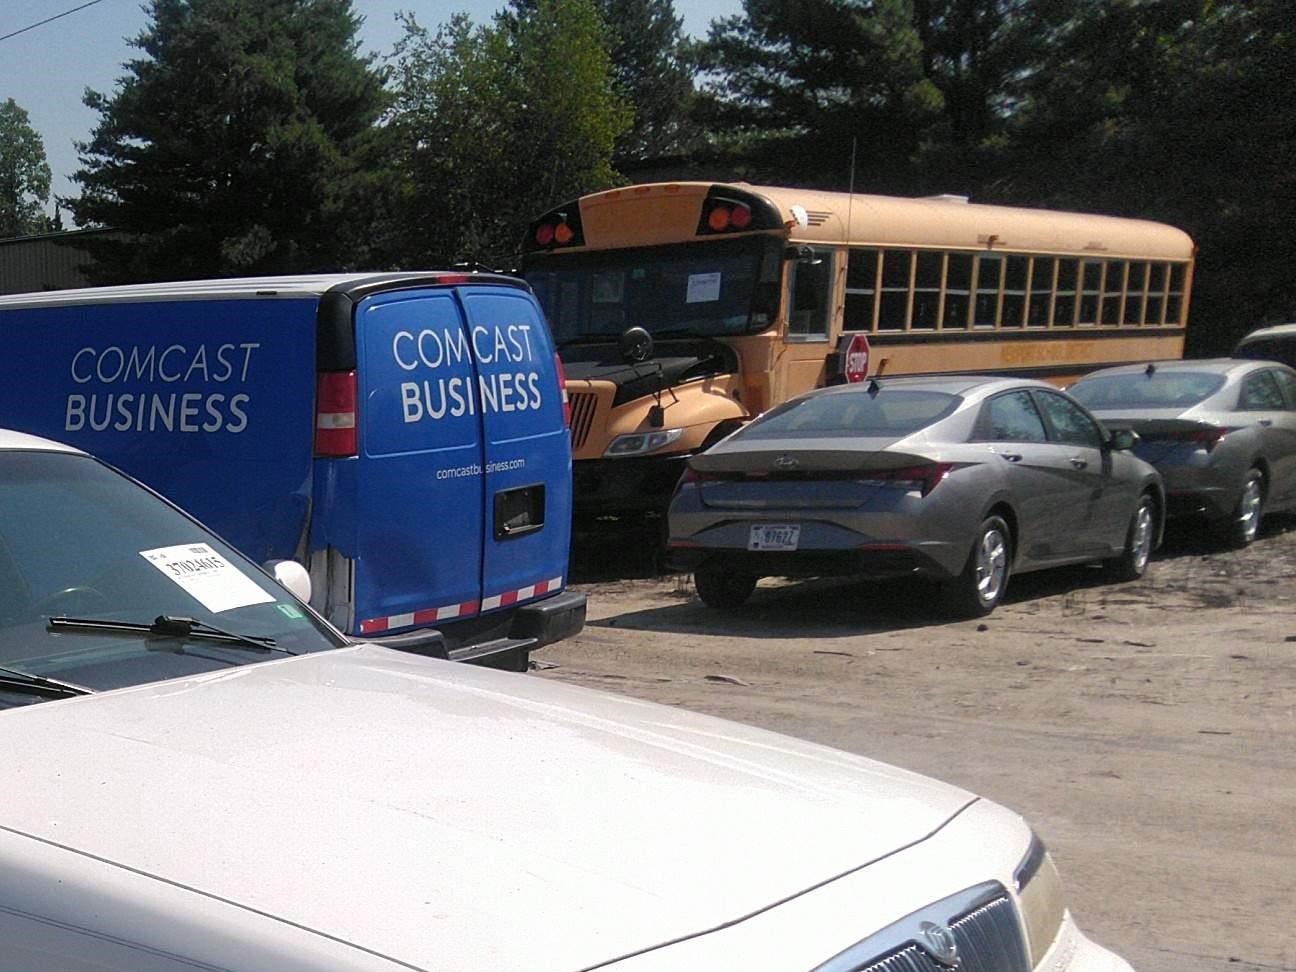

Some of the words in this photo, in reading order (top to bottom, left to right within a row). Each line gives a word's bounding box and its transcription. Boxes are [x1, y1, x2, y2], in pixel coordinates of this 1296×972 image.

[71, 343, 260, 383] COMCAST
[393, 325, 532, 370] COMCAST
[848, 352, 867, 373] STOP
[65, 393, 250, 432] BUSINESS
[401, 372, 541, 423] BUSINESS
[436, 459, 525, 479] comcastbusiness.com
[165, 556, 225, 576] 37024615
